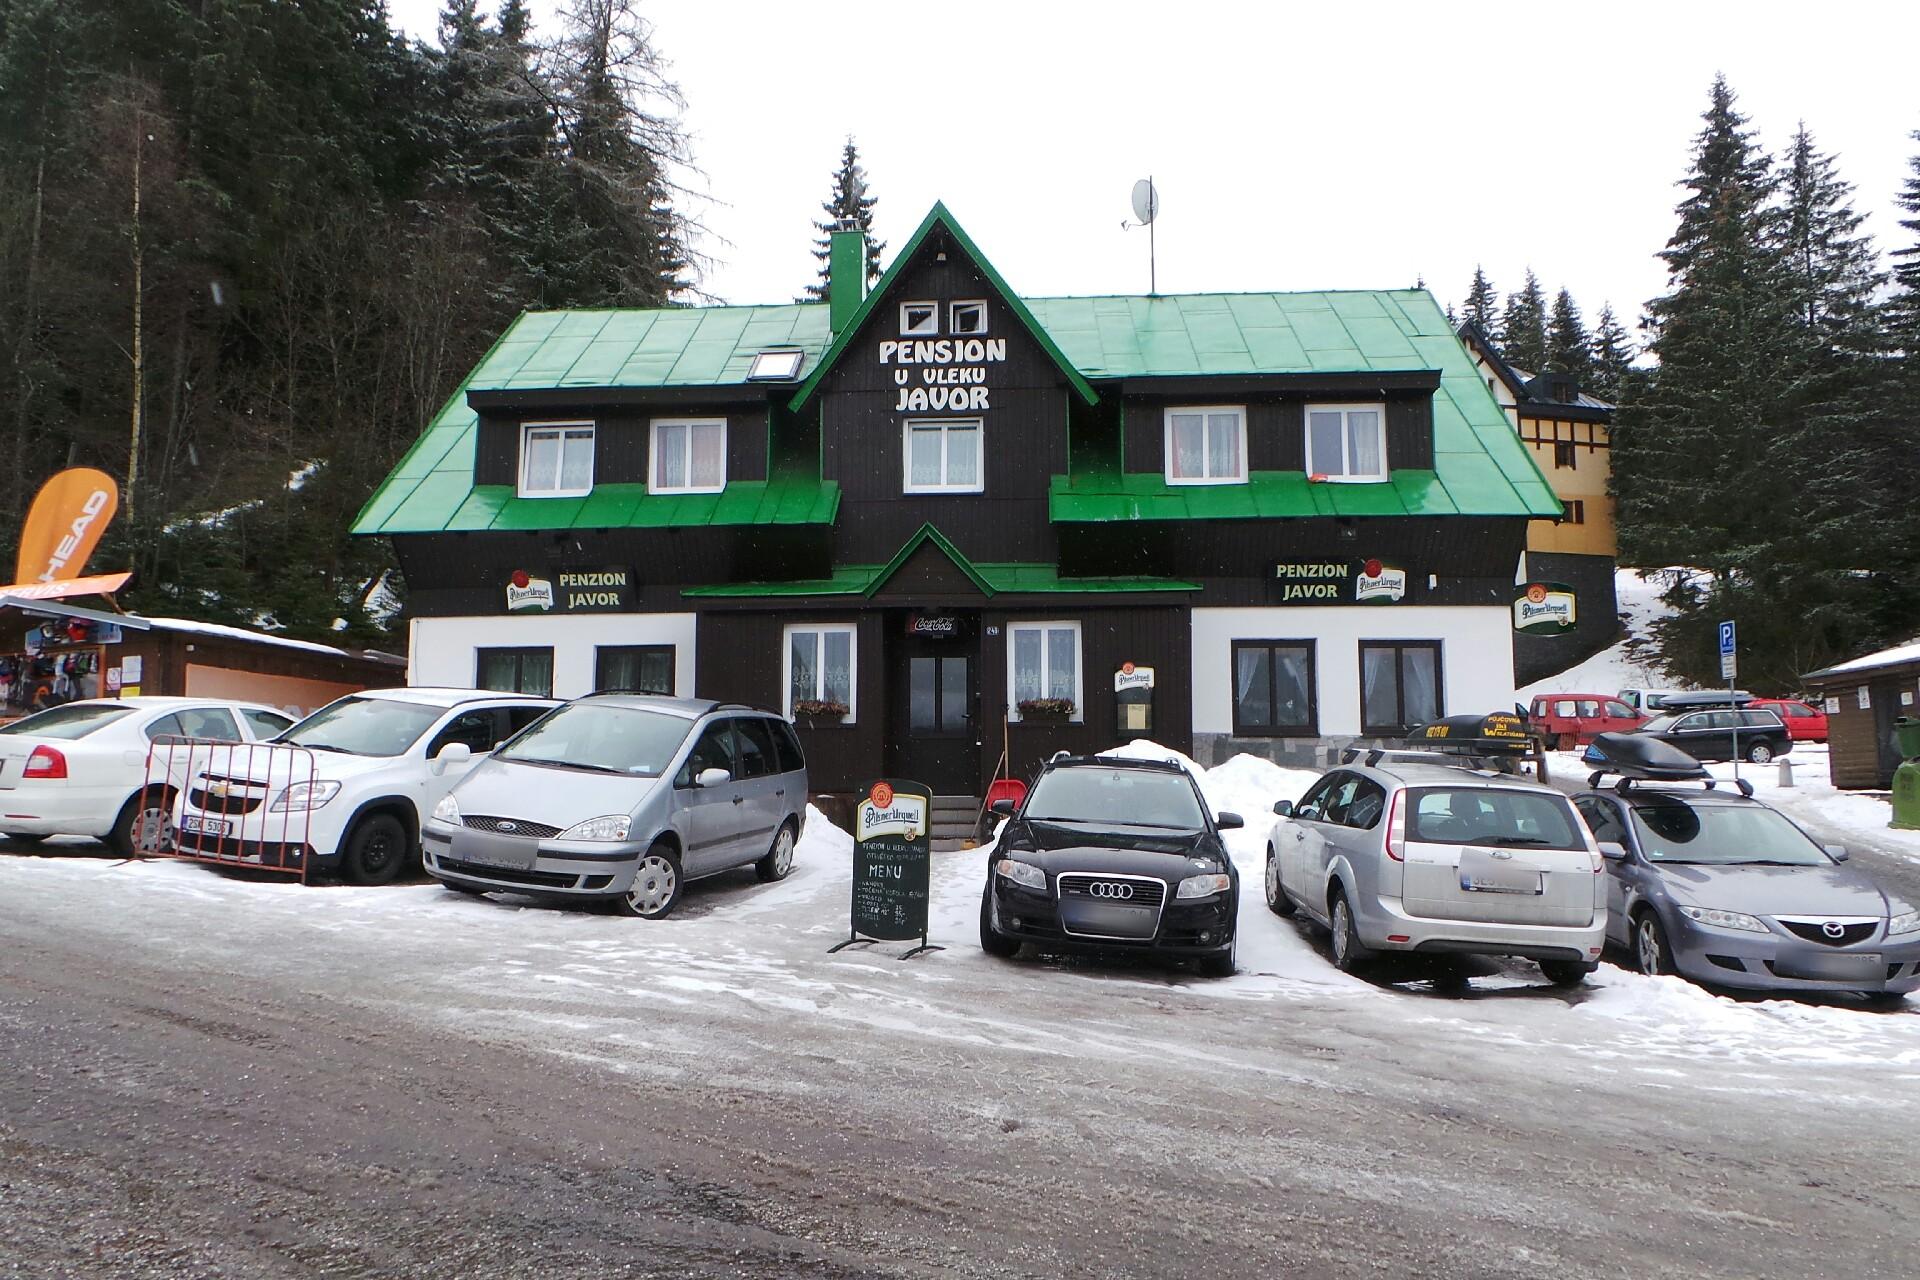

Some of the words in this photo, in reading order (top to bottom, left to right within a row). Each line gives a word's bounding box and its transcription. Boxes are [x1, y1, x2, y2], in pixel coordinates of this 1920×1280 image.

[879, 338, 1006, 364] PENSION
[894, 369, 908, 385] U
[923, 367, 986, 384] VLEKU
[896, 386, 990, 411] JAVOR
[38, 490, 108, 583] HEAD
[559, 572, 626, 587] PENZION
[1276, 564, 1348, 578] PENZION
[568, 592, 620, 609] JAVOR
[1283, 584, 1338, 600] JAVOR
[1722, 626, 1731, 645] P
[865, 807, 893, 828] Pilsner
[893, 807, 919, 824] Urquell
[869, 864, 902, 879] MENU
